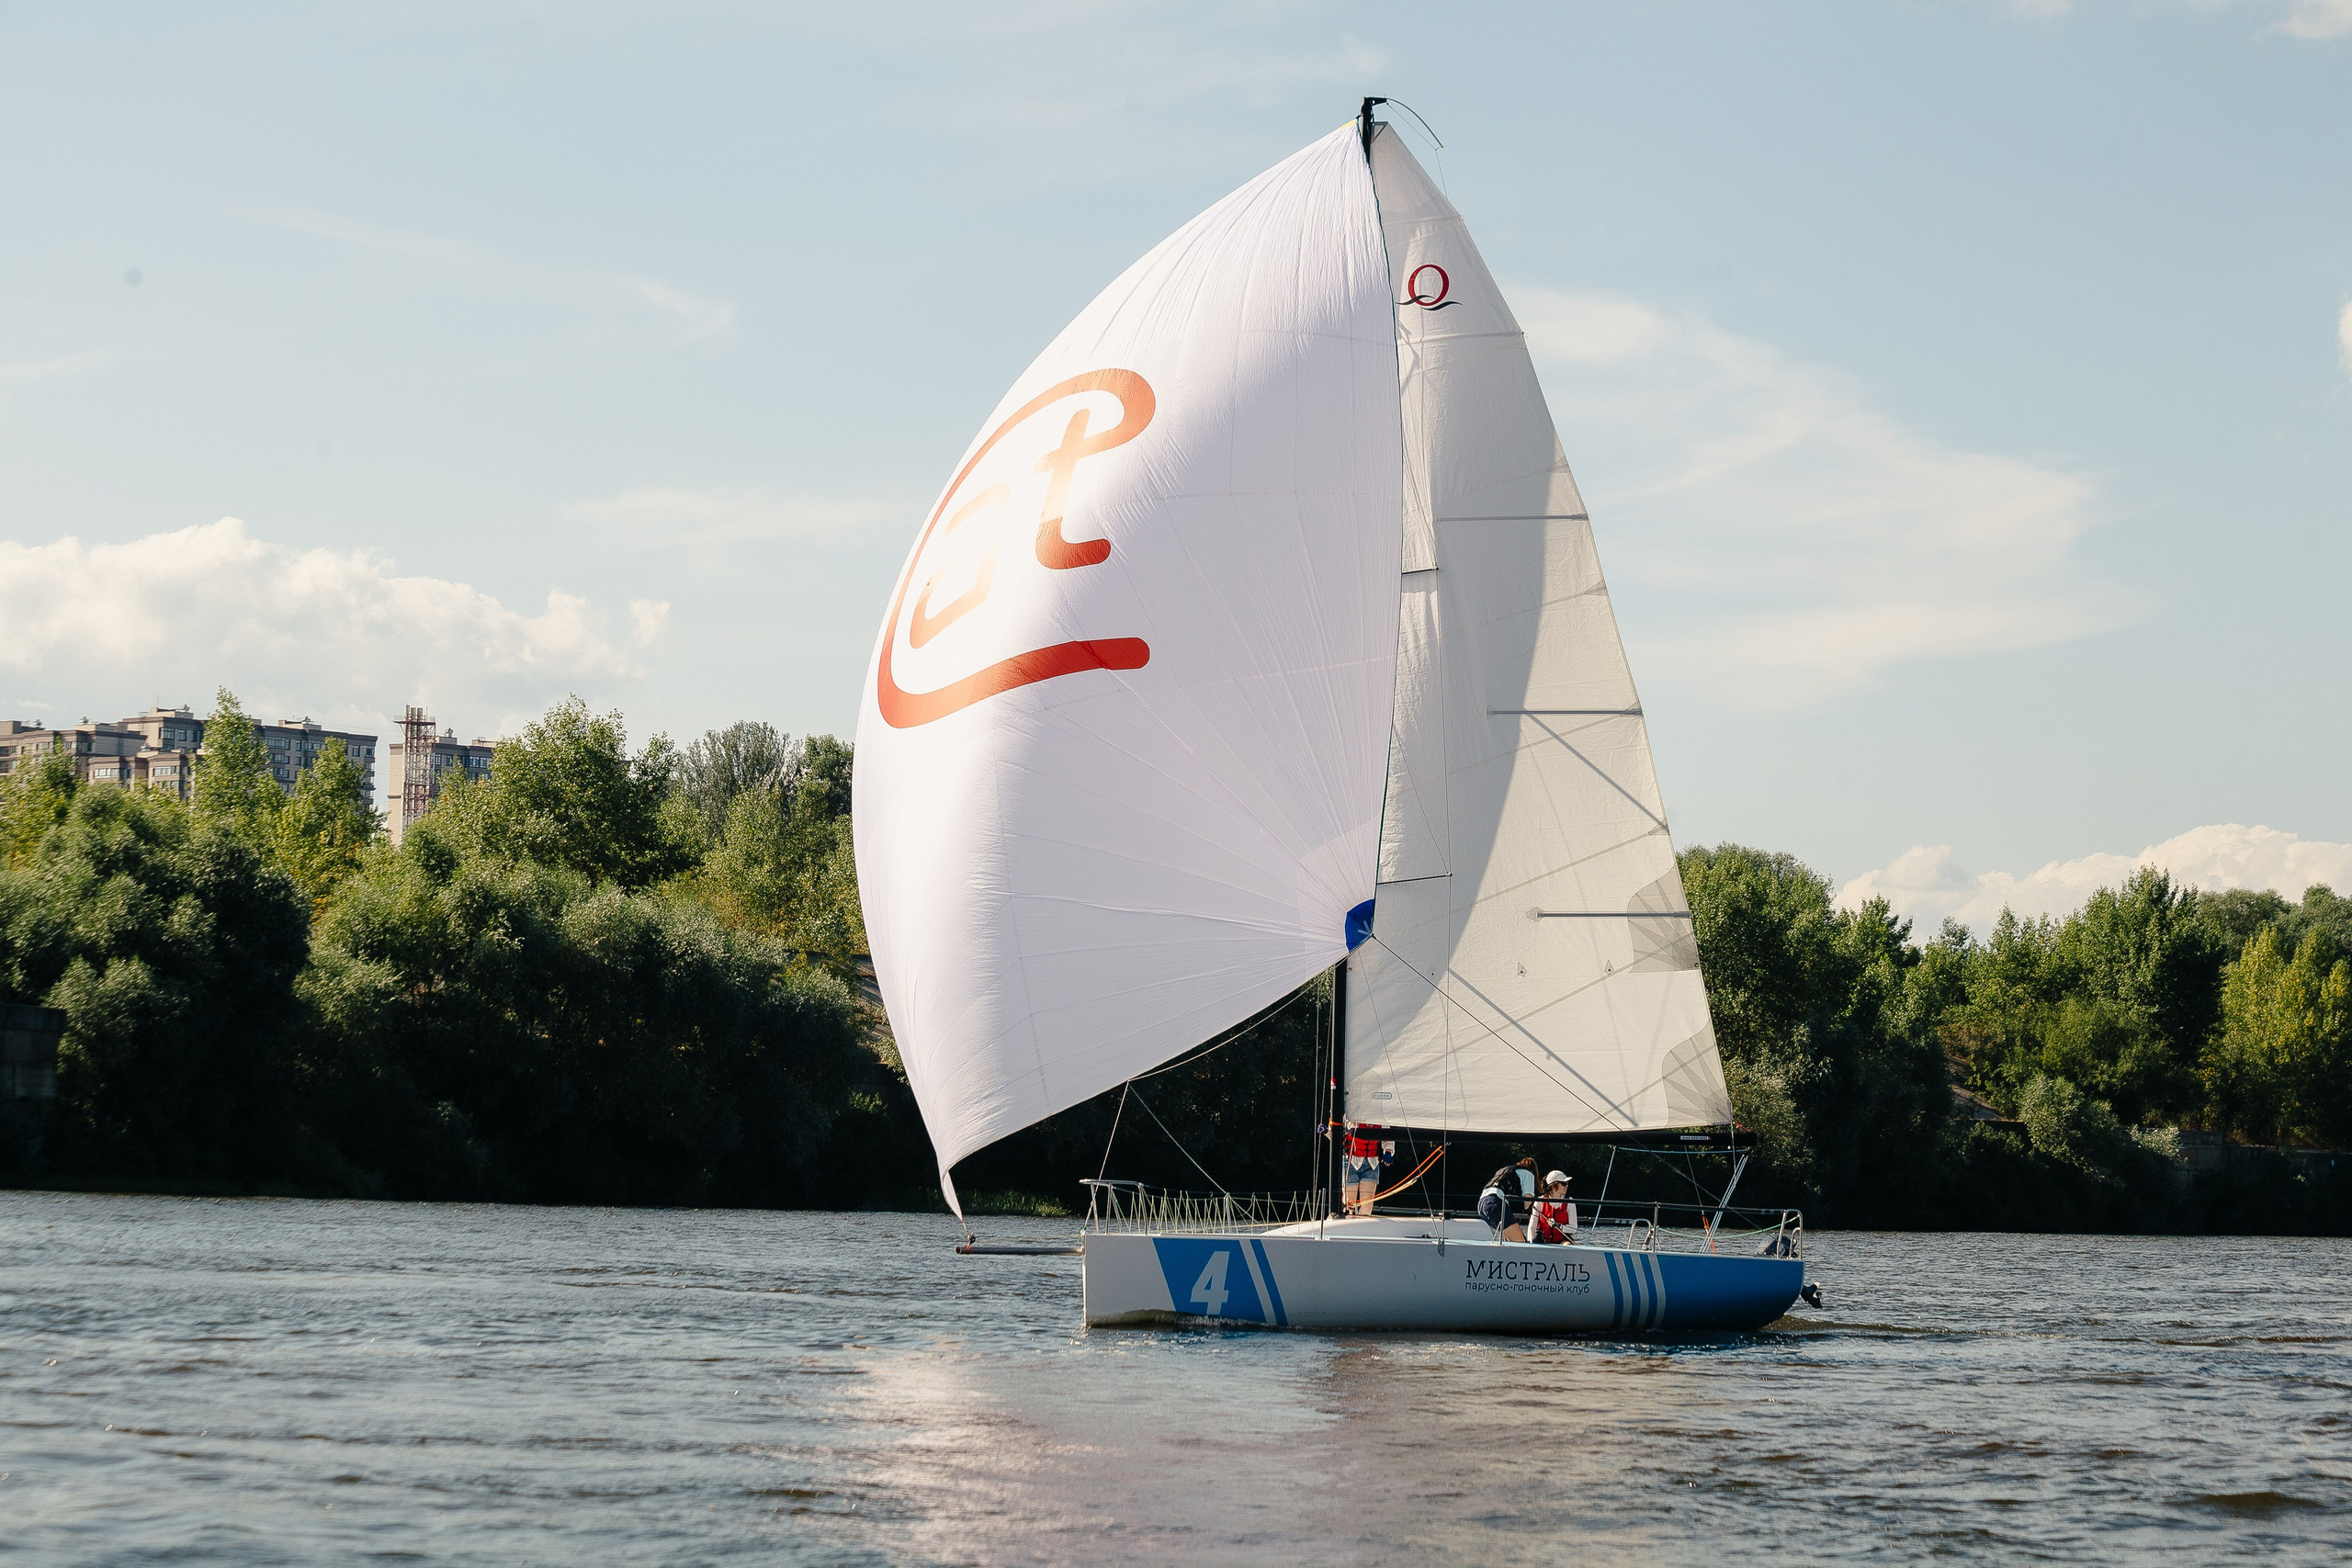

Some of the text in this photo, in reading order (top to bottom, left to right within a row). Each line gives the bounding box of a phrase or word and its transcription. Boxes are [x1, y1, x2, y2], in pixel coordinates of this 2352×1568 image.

[1395, 264, 1463, 310] Q
[1191, 1251, 1229, 1315] 4
[1465, 1259, 1590, 1281] МИСТРАЛЬ
[1464, 1281, 1589, 1296] парусно-гоночный клуб
